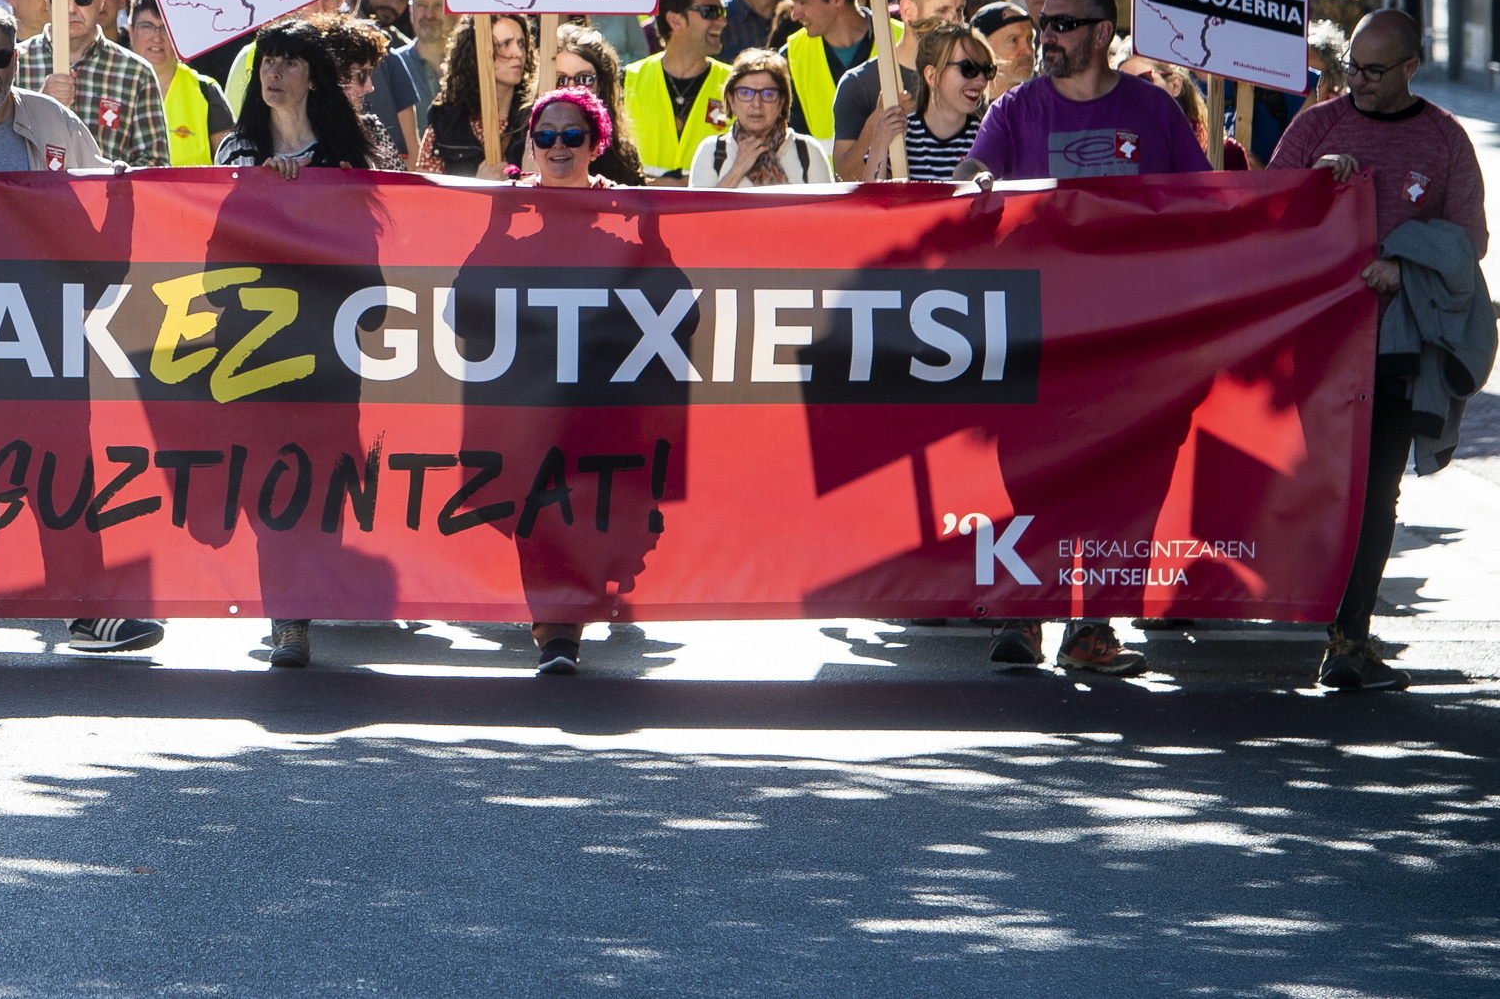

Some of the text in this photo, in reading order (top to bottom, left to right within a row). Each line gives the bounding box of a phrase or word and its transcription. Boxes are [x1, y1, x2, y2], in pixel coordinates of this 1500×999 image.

[150, 267, 315, 403] EZ
[332, 285, 1007, 384] GUTXIETSI
[1059, 539, 1256, 559] EUSKALGINTZAREN
[1059, 568, 1189, 586] KONTSEILUA
